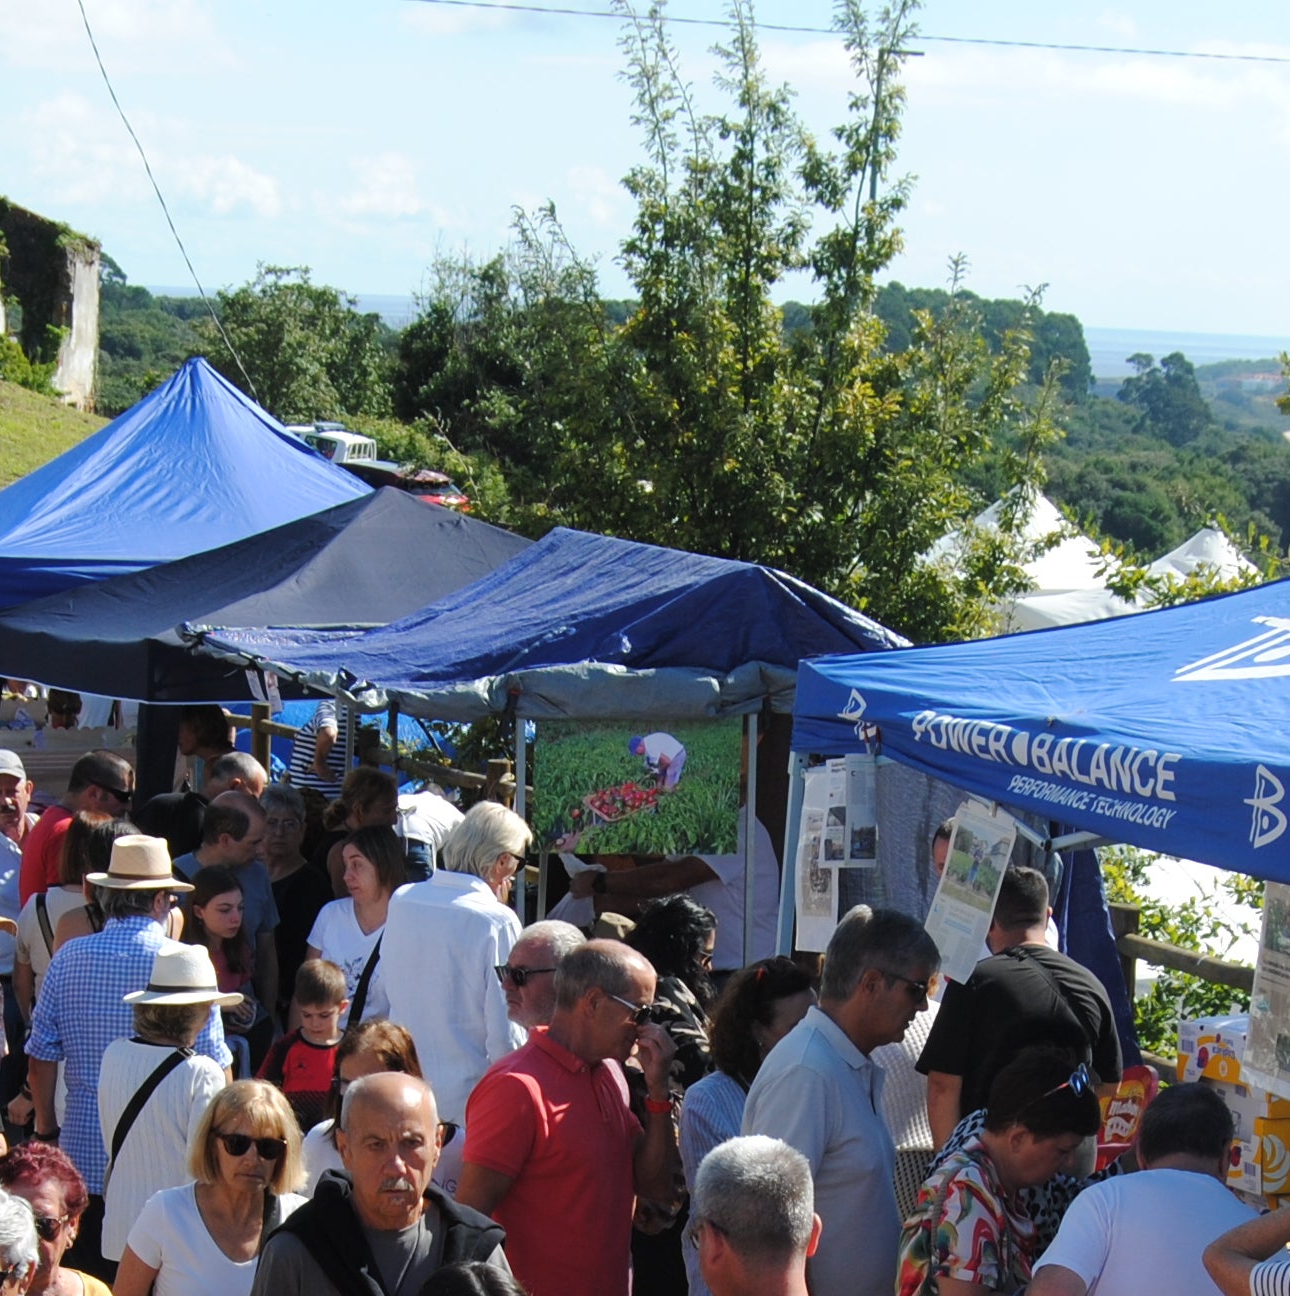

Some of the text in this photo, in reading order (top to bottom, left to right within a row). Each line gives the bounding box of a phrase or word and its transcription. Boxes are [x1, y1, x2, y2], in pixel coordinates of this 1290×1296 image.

[912, 710, 1184, 802] POWER BALANCE
[1007, 775, 1178, 829] PERFORMANCE TECHNOLOGY
